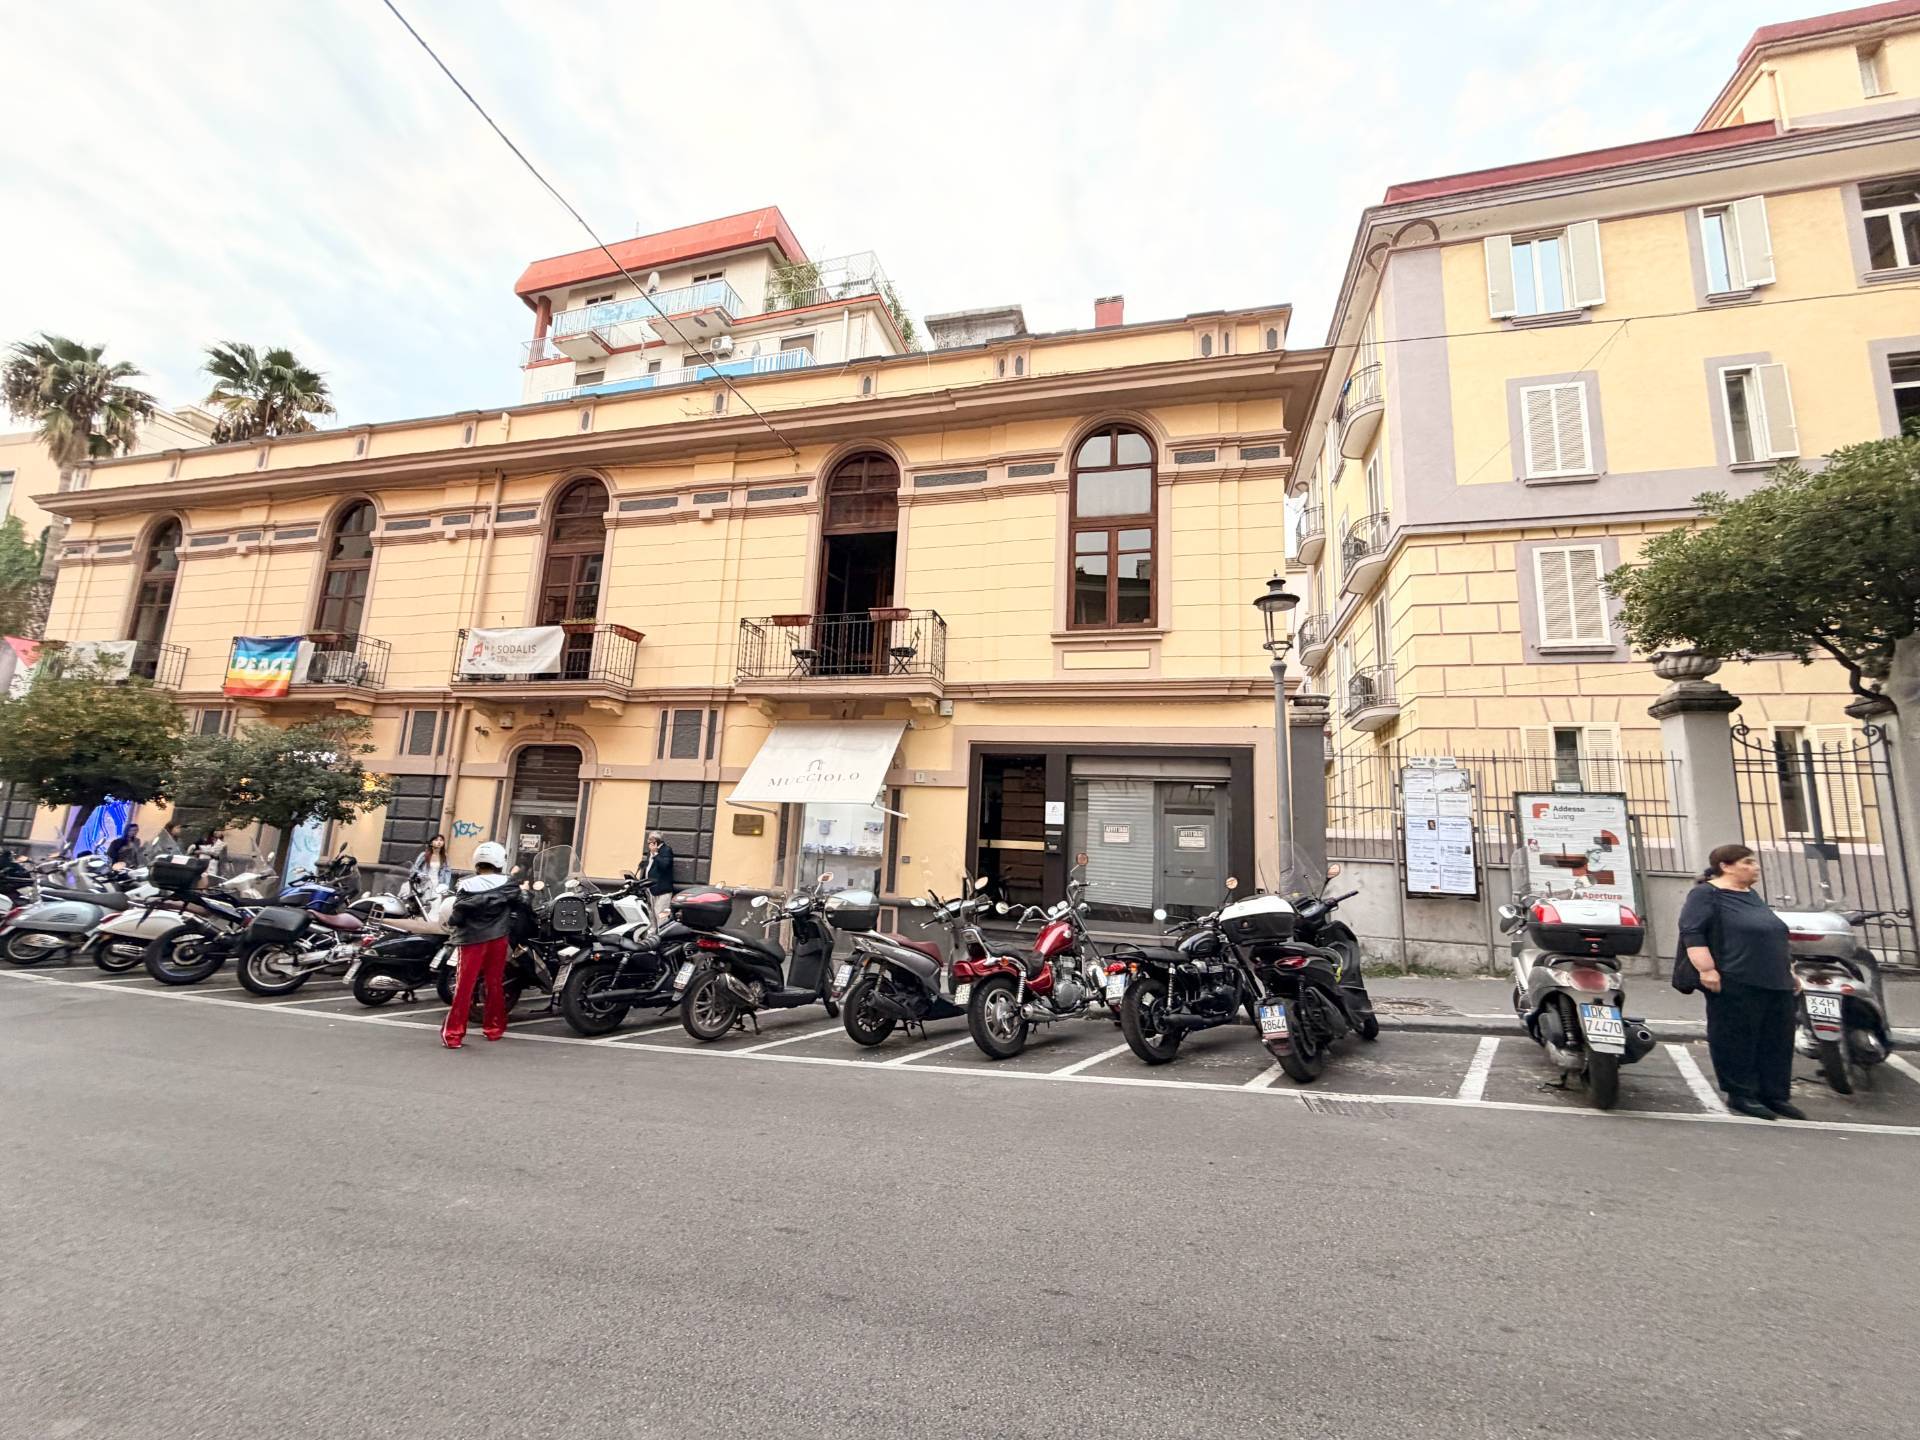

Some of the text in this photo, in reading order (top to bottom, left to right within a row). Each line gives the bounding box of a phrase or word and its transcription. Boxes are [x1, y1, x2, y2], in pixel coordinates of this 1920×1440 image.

[496, 644, 537, 655] SODALIS
[236, 656, 292, 672] PEACE
[768, 772, 860, 787] MUCCIOLO
[1553, 805, 1586, 813] Addesso
[1553, 814, 1575, 822] Living
[1583, 891, 1623, 901] Apertura
[1590, 1006, 1606, 1020] DK
[1585, 1019, 1622, 1034] 74470
